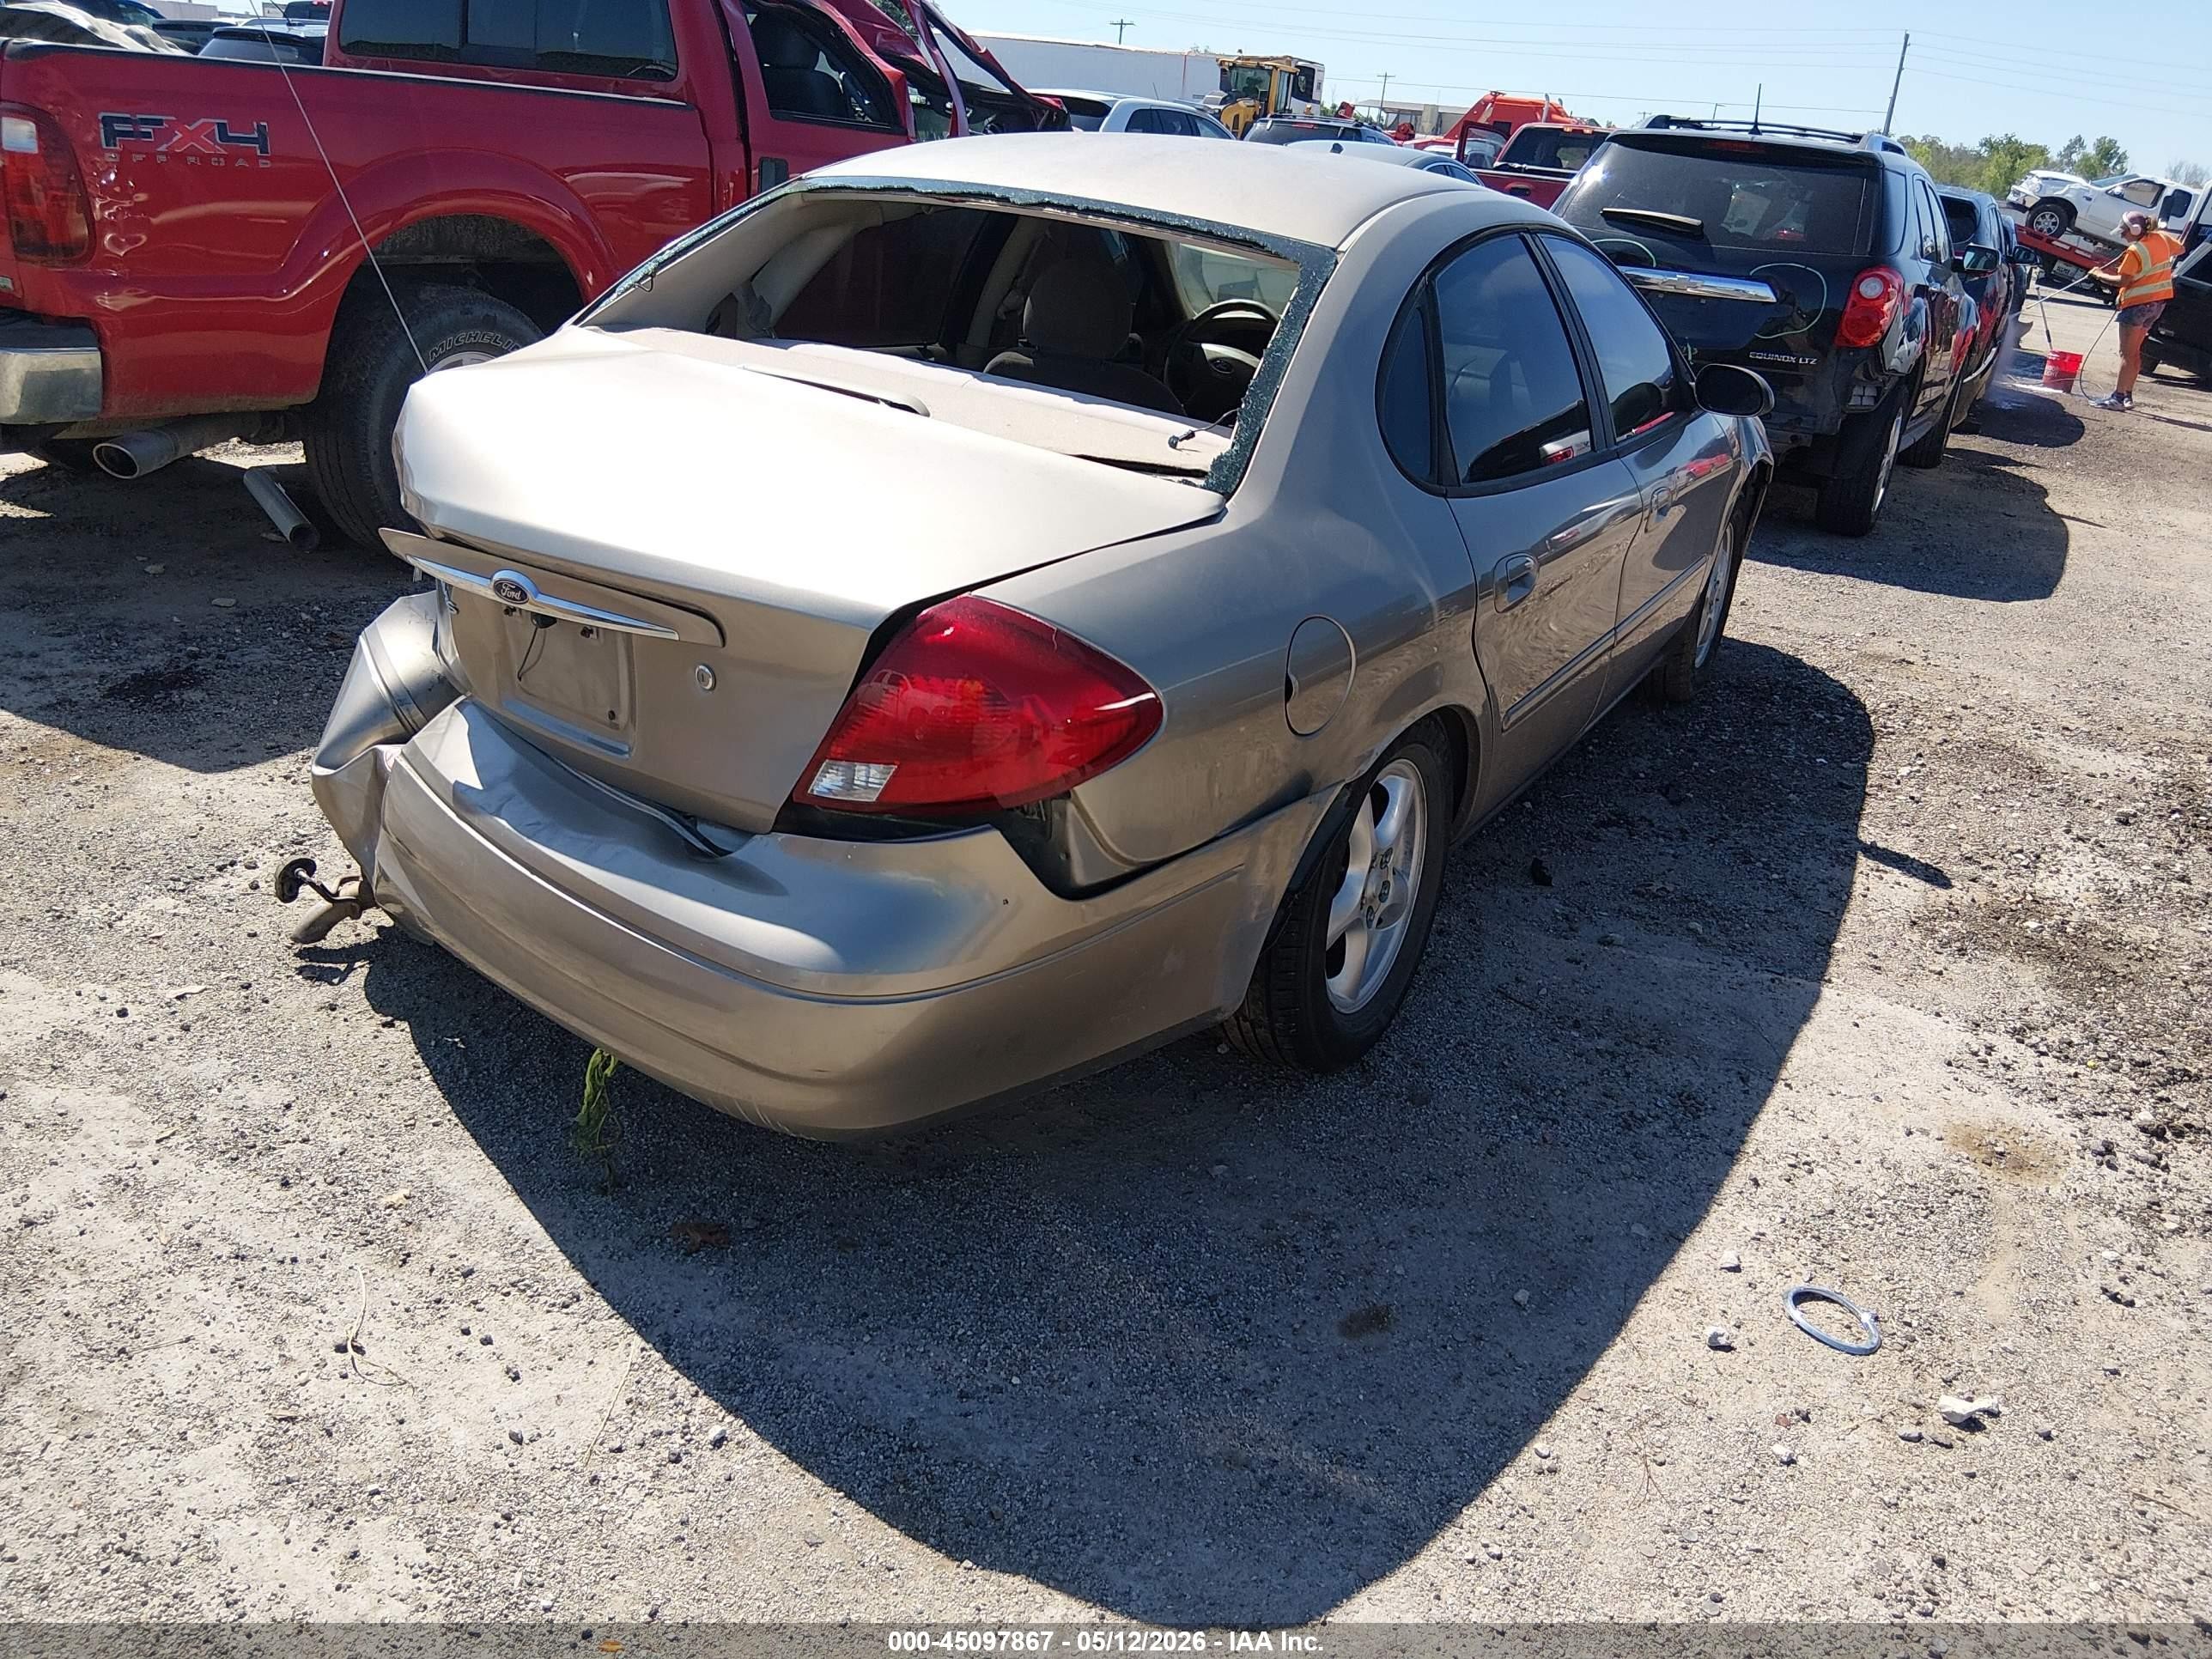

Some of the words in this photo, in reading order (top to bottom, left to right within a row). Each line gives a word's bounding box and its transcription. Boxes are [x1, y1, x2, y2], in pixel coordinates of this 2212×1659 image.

[99, 112, 270, 155] FX4
[104, 152, 170, 165] OFF
[186, 155, 271, 168] ROAD
[1749, 351, 1796, 363] EQUINOX
[501, 582, 522, 600] Ford
